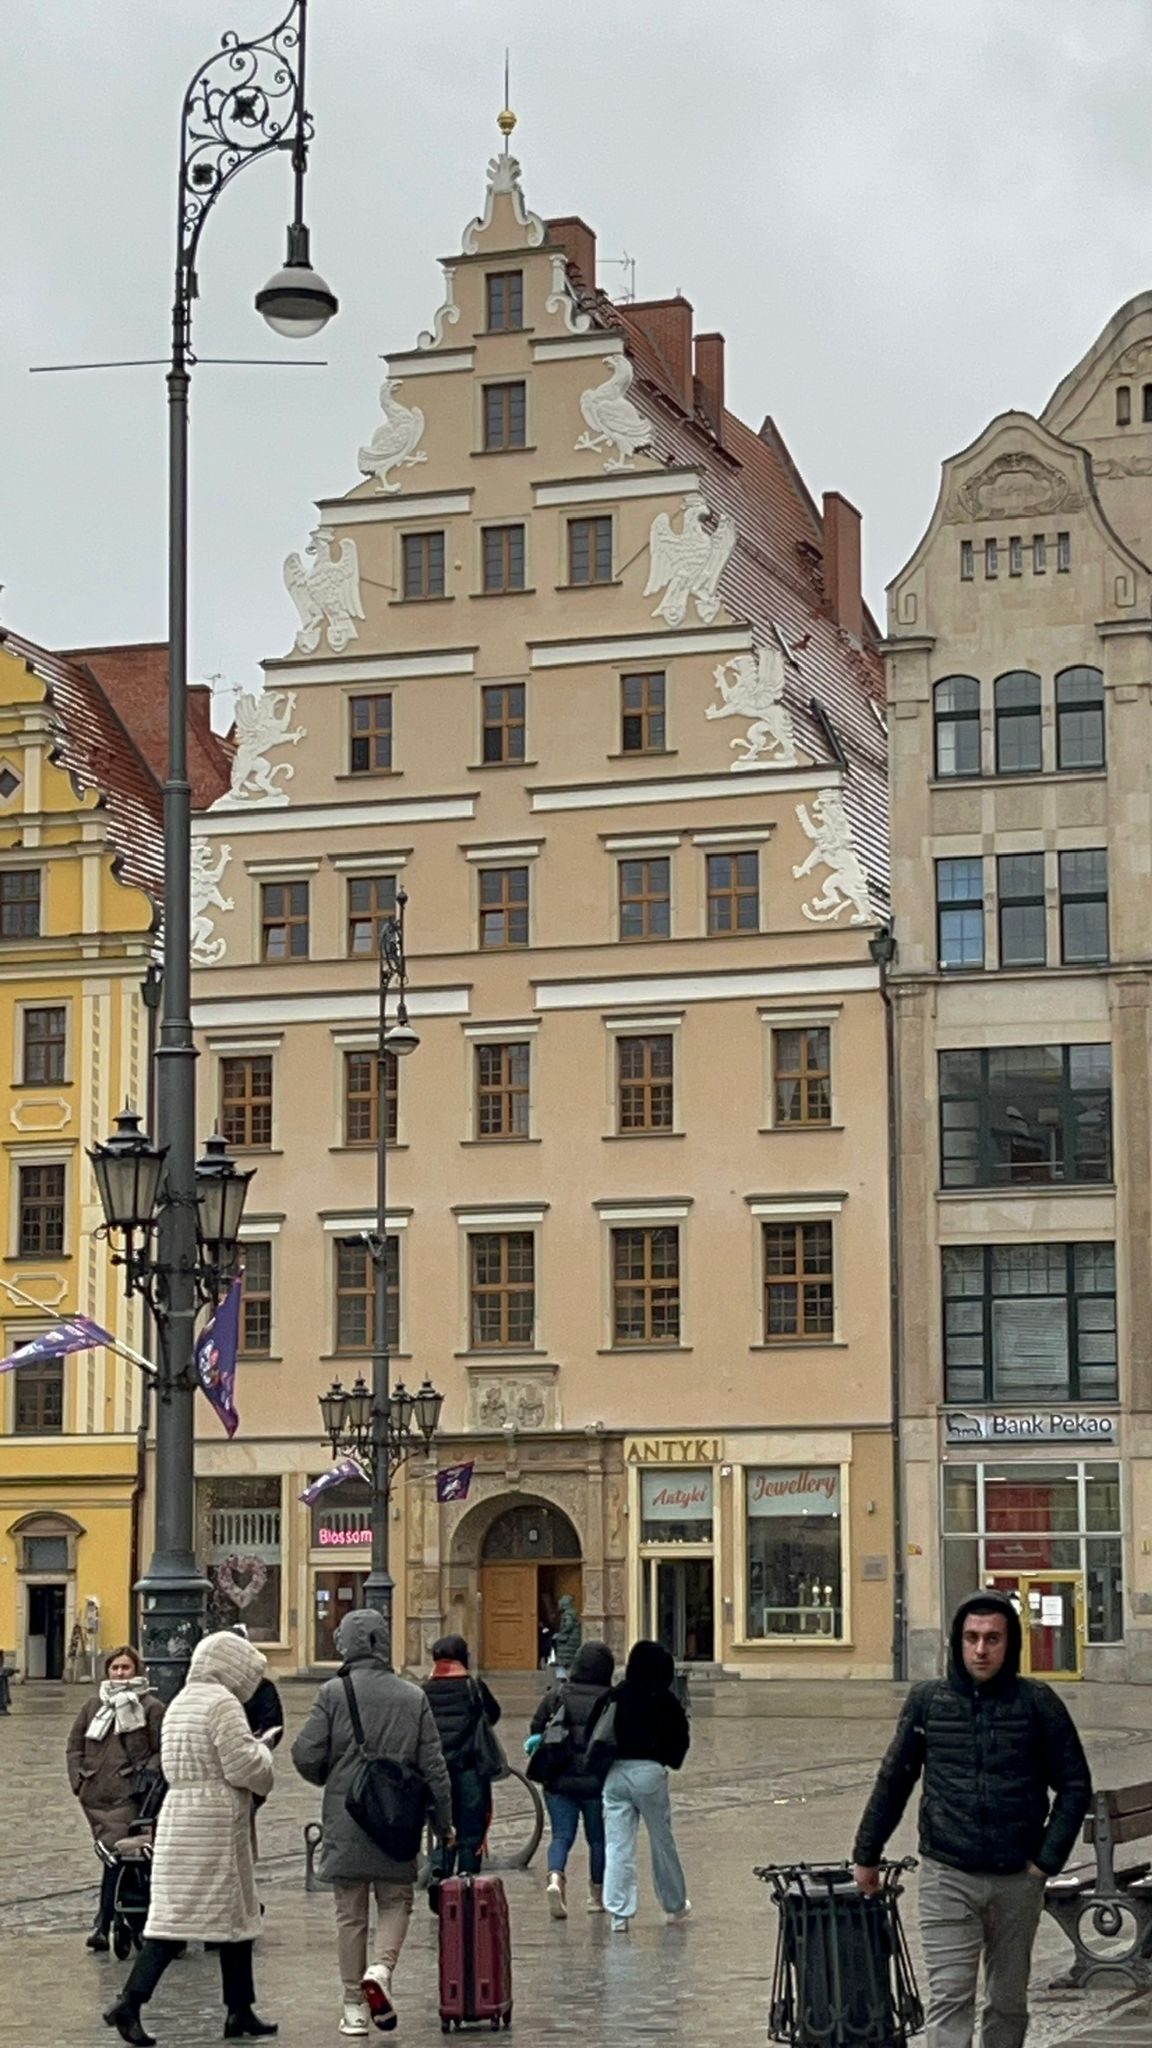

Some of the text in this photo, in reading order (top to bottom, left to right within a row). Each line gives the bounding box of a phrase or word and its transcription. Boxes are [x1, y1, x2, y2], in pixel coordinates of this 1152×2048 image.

[993, 1414, 1113, 1434] Bank Pekao
[627, 1440, 723, 1462] ANTYKI
[652, 1485, 708, 1508] Antyki
[752, 1472, 837, 1501] Jewellery
[319, 1529, 373, 1545] Blossom
